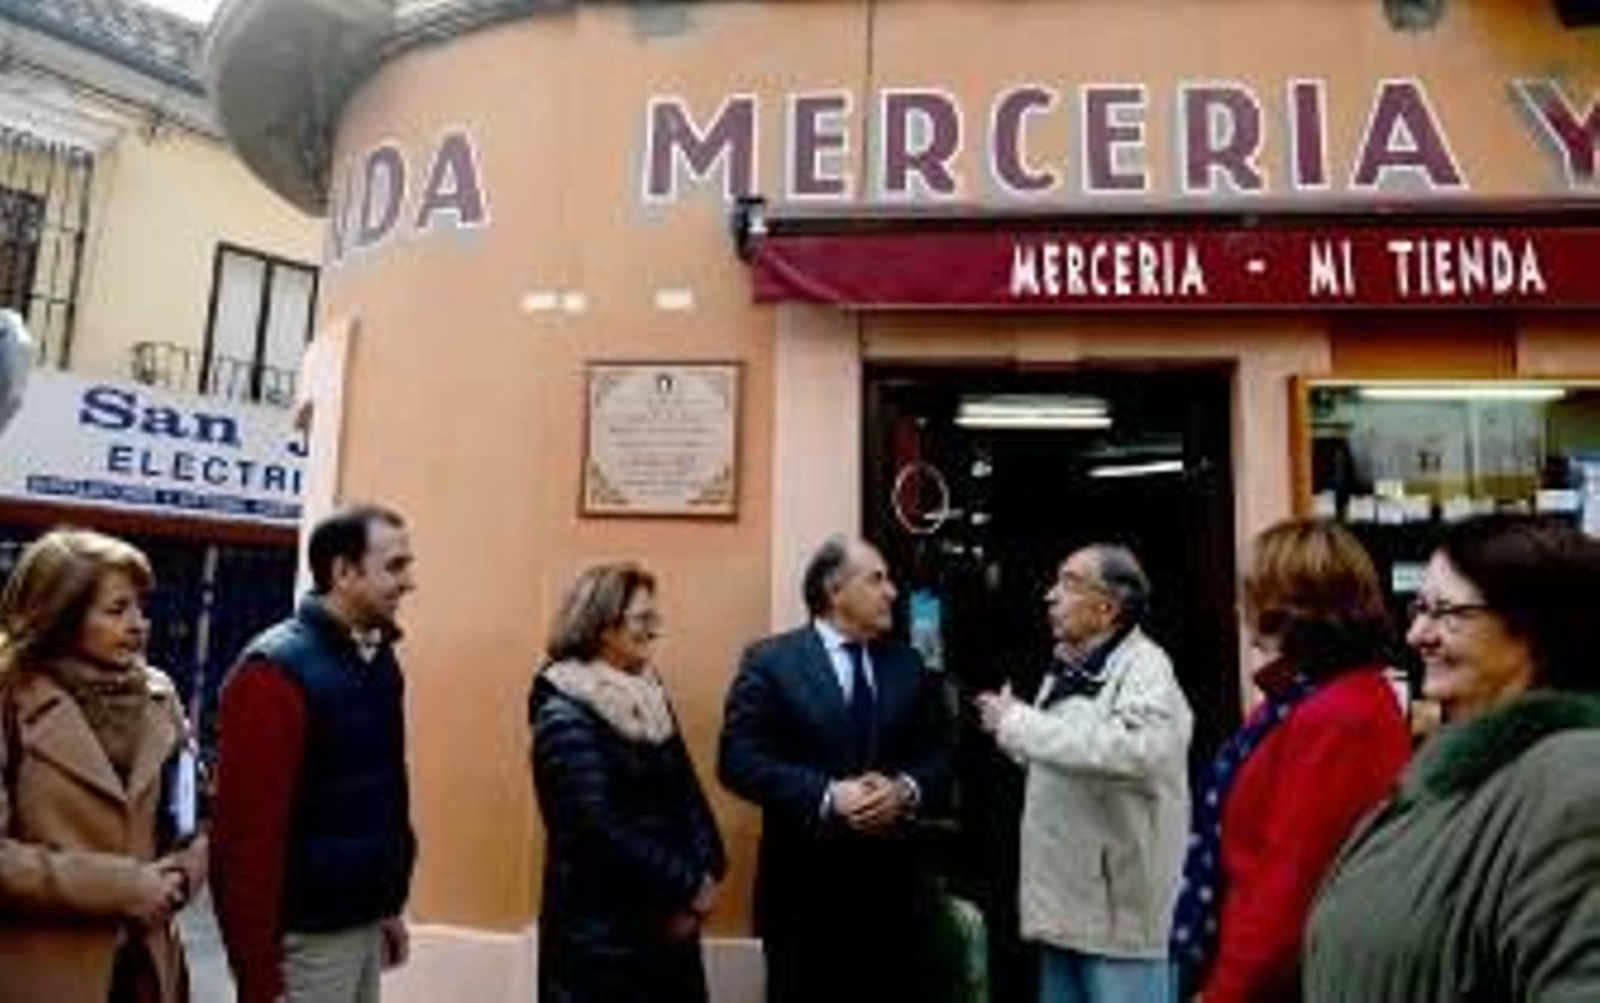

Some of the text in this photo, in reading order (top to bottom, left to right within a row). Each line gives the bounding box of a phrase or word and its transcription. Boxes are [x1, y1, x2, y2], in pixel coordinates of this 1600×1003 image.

[642, 77, 1470, 203] MERCERIA
[1010, 239, 1207, 297] MERCERIA
[1309, 238, 1355, 295] MI
[1386, 237, 1547, 298] TIENDA
[78, 386, 242, 448] San
[107, 446, 302, 495] ELECTRI
